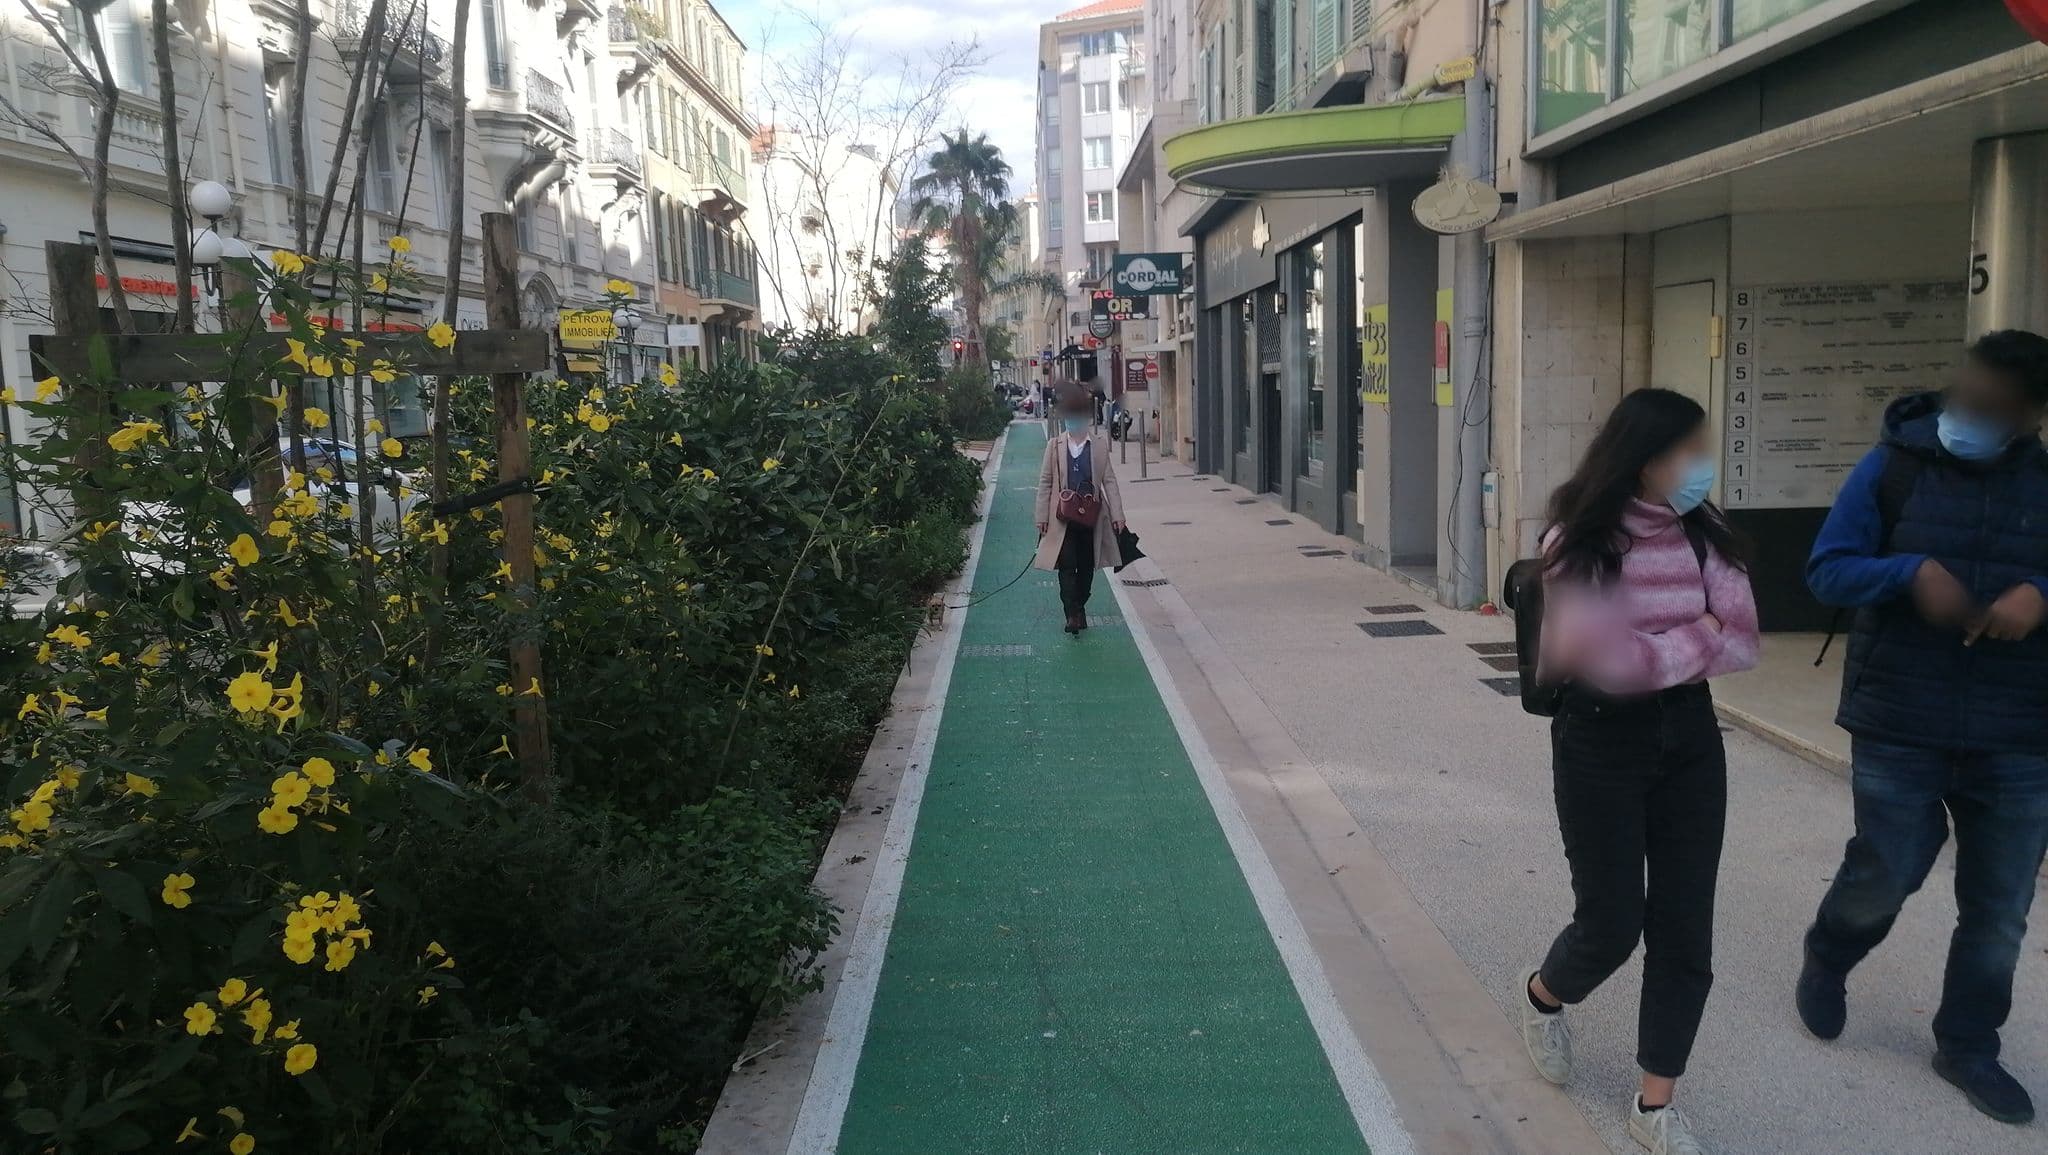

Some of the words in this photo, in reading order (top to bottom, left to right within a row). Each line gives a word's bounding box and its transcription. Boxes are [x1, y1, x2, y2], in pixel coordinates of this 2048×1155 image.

[1117, 270, 1178, 284] CORDIAL
[1107, 298, 1133, 313] OR
[1737, 292, 1748, 306] 8
[563, 314, 612, 324] PETROVA
[1737, 317, 1747, 330] 7
[564, 327, 615, 337] IMMOBILIER
[1736, 343, 1747, 355] 6
[1735, 367, 1746, 380] 5
[1734, 391, 1746, 404] 4
[1734, 416, 1745, 429] 3
[1734, 440, 1745, 453] 2
[1735, 464, 1743, 477] 1
[1734, 488, 1742, 501] 1
